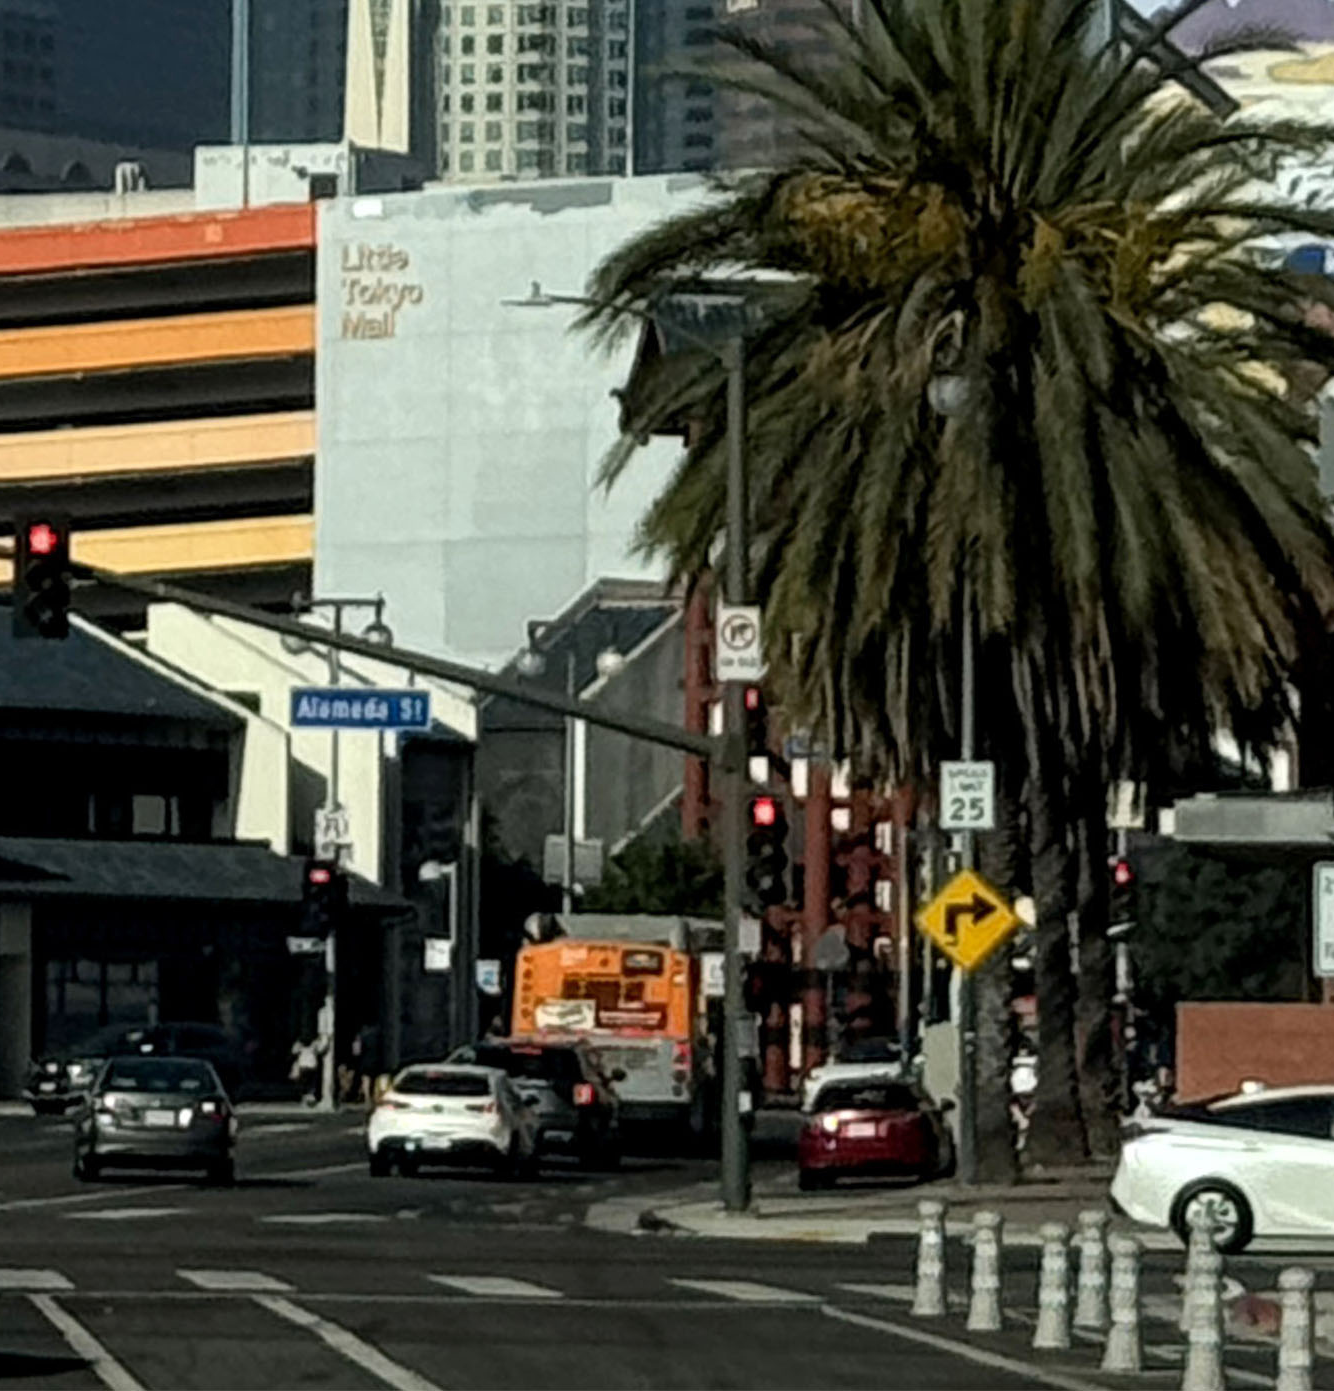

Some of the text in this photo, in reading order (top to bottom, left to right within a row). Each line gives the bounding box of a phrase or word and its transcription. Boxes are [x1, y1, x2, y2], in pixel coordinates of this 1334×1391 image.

[341, 241, 409, 272] Little
[341, 277, 424, 314] Tokyo
[341, 309, 396, 340] Mall
[296, 695, 424, 722] Alameda St
[949, 796, 985, 822] 25
